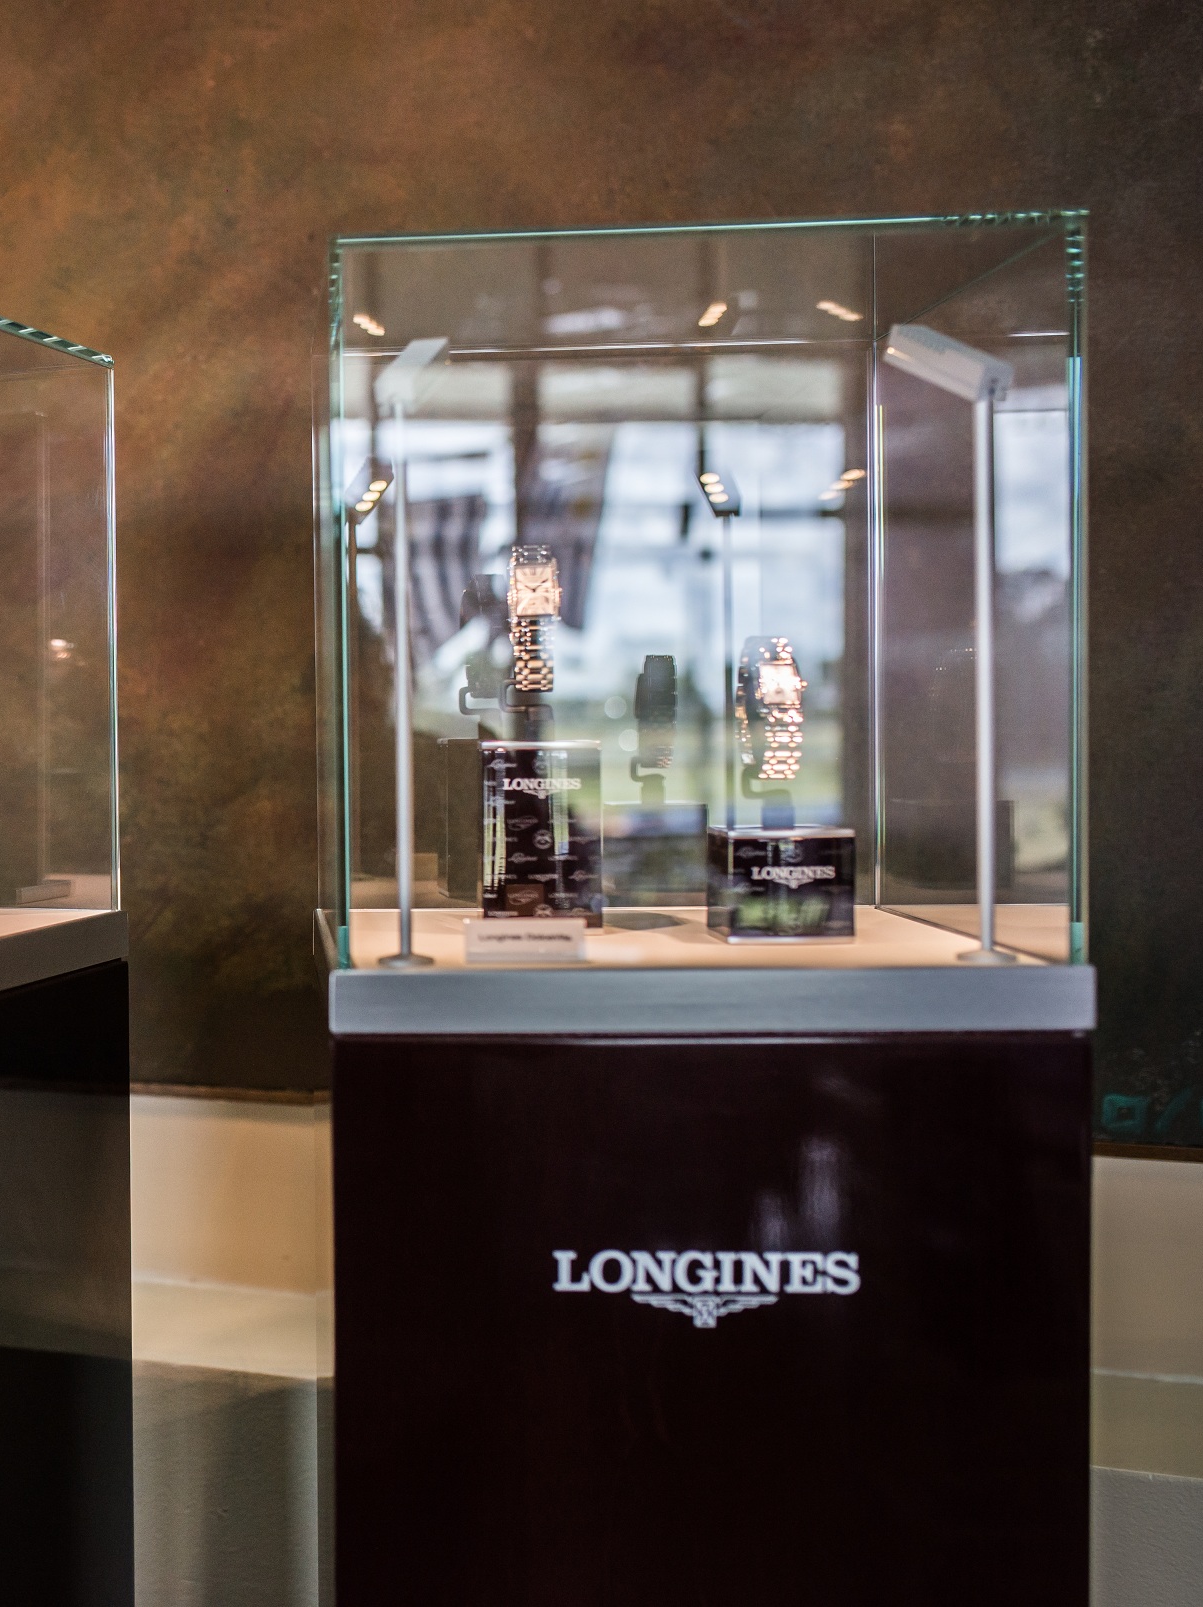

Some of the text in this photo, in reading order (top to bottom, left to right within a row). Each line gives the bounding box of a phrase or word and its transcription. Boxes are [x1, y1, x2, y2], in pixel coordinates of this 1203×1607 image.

[502, 778, 581, 790] LONGINES
[750, 866, 836, 880] LONGINES
[552, 1249, 861, 1296] LONGINES
